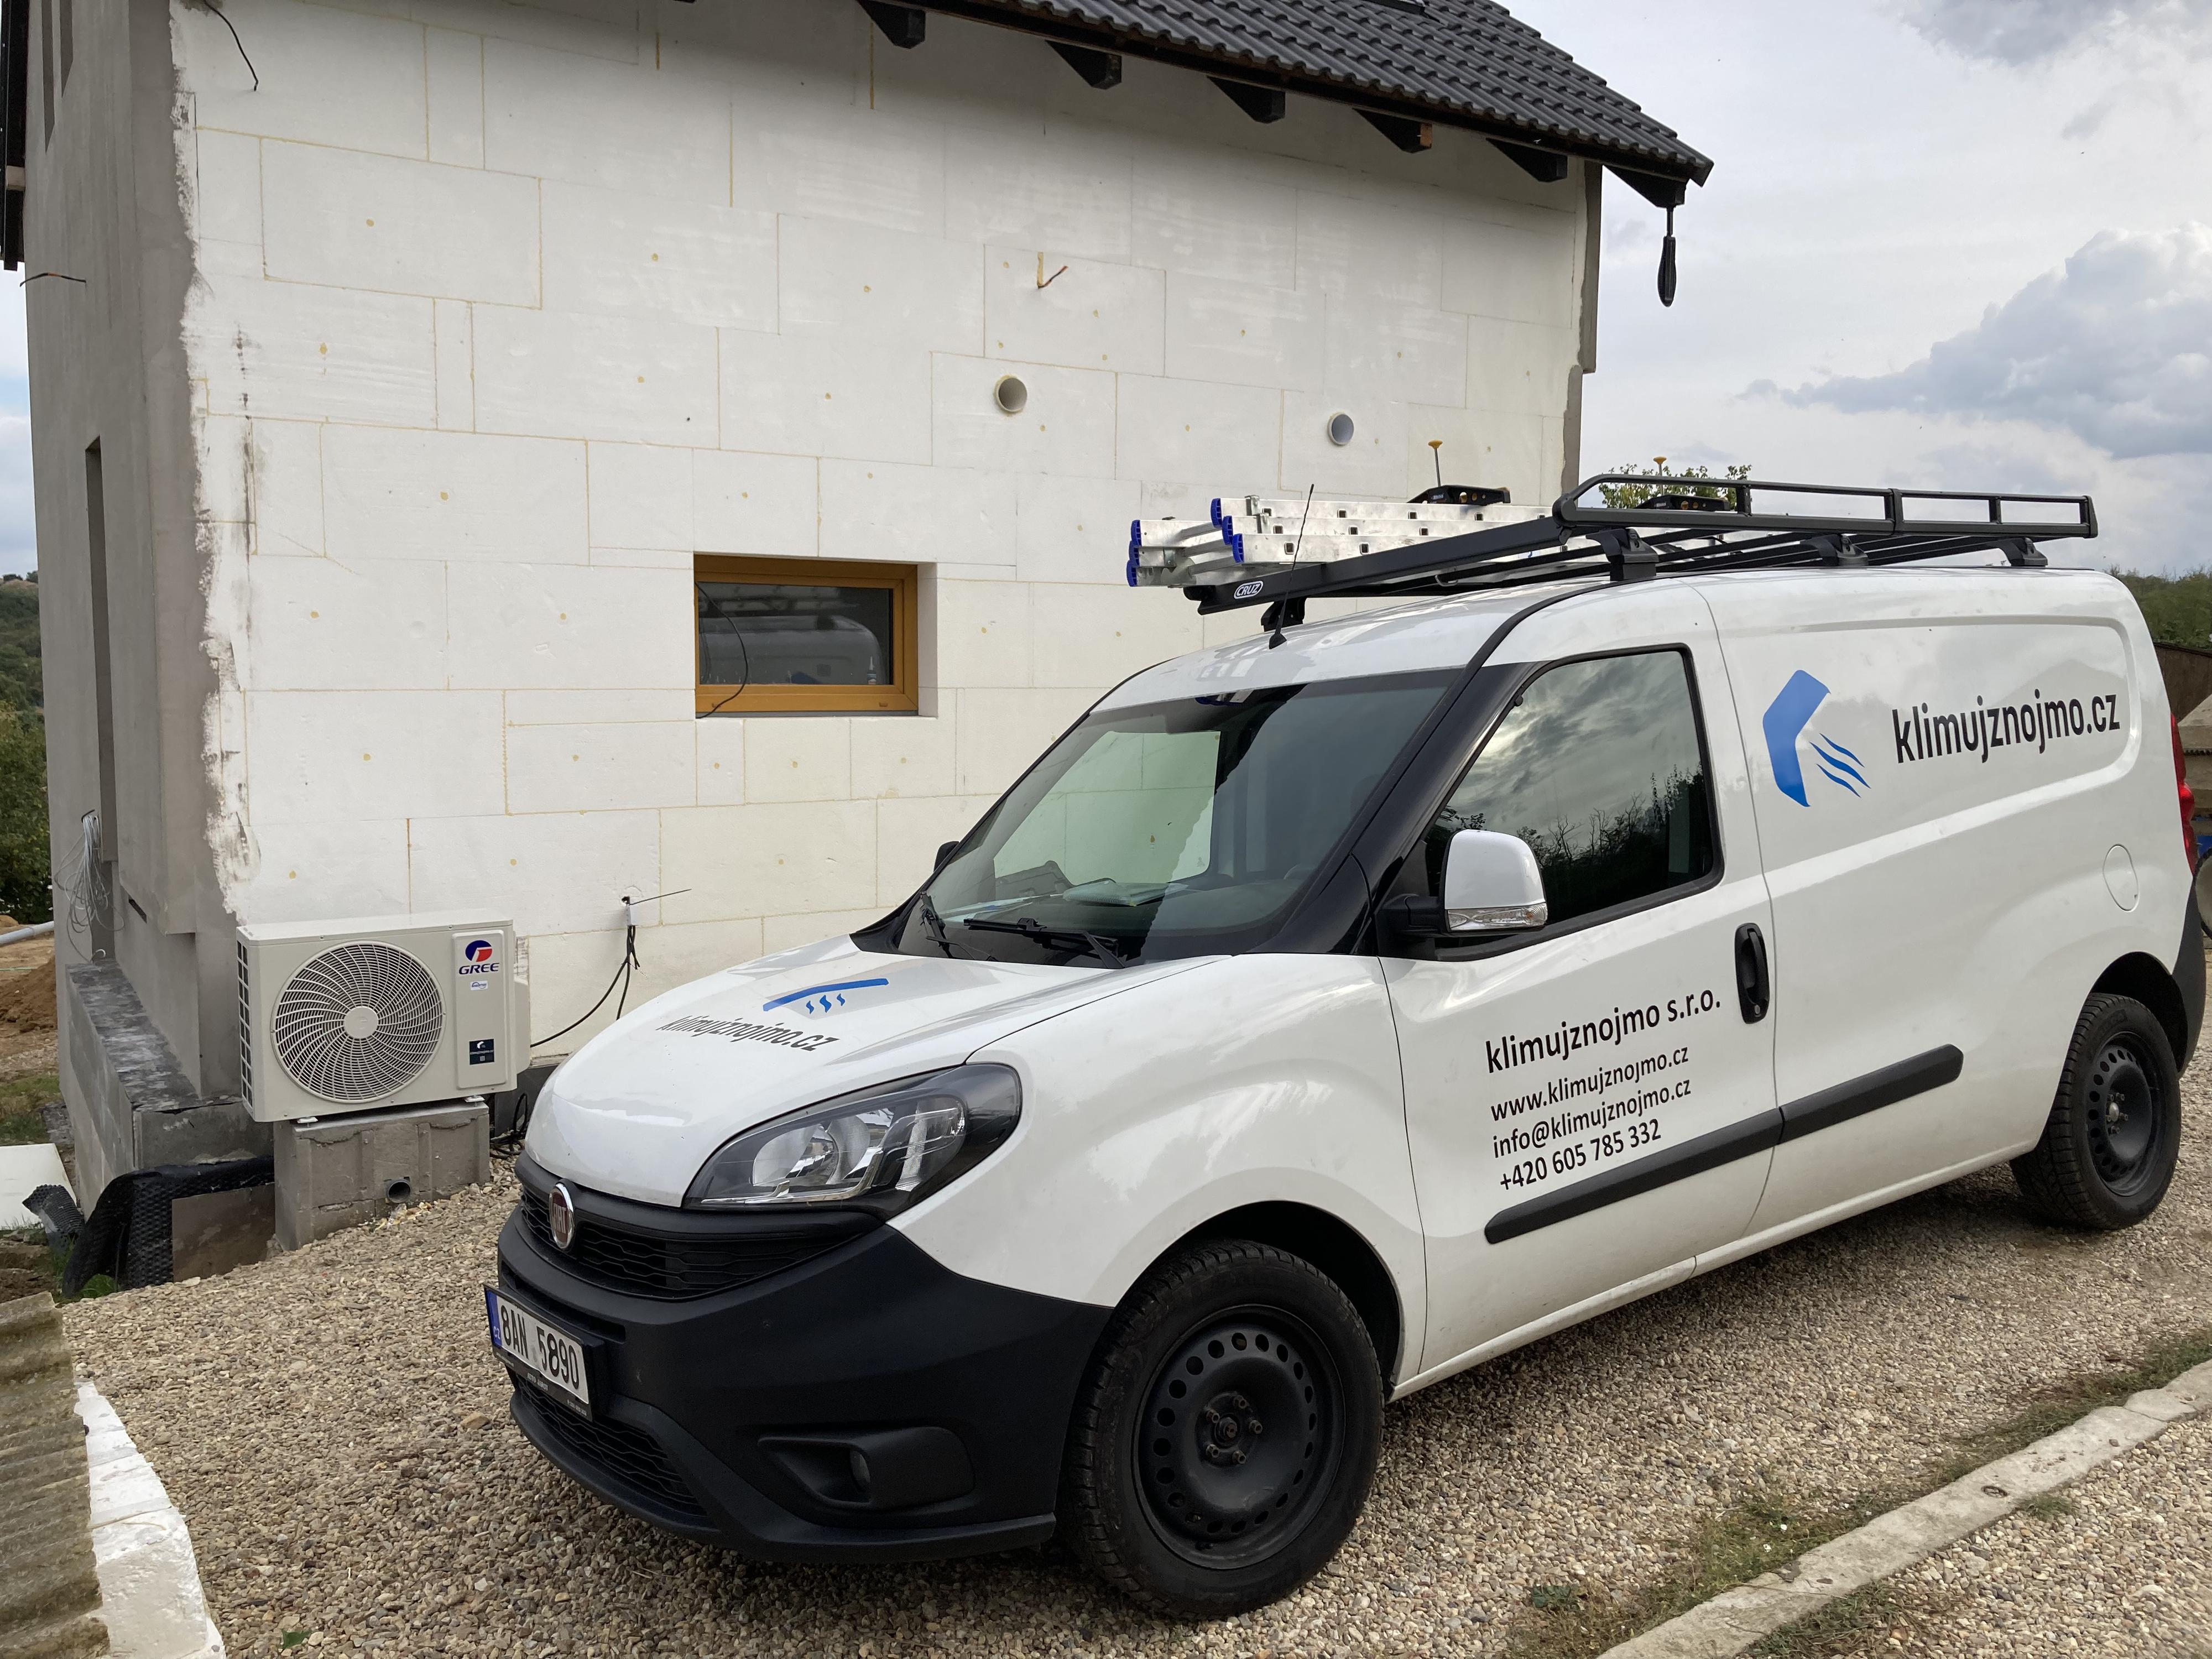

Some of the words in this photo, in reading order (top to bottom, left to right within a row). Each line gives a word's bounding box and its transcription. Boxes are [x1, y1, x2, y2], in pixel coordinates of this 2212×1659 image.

[1236, 583, 1261, 596] CRUZ
[1891, 688, 2121, 764] klimujznojmo.cz
[458, 962, 500, 975] GREE
[655, 1015, 841, 1051] klimujznojmo.cz
[1485, 1006, 1660, 1073] klimujznojmo
[1667, 989, 1721, 1022] s.r.o.
[1490, 1046, 1689, 1121] www.klimujznojmo.cz
[1493, 1079, 1691, 1159] info@klimujznojmo.cz
[1500, 1157, 1547, 1191] +420
[1552, 1143, 1587, 1174] 605
[1590, 1130, 1624, 1161] 785
[1627, 1118, 1662, 1148] 332
[552, 1203, 567, 1234] FIAT
[493, 1326, 501, 1340] CZ
[500, 1305, 529, 1360] 8AN
[536, 1326, 580, 1390] 5890
